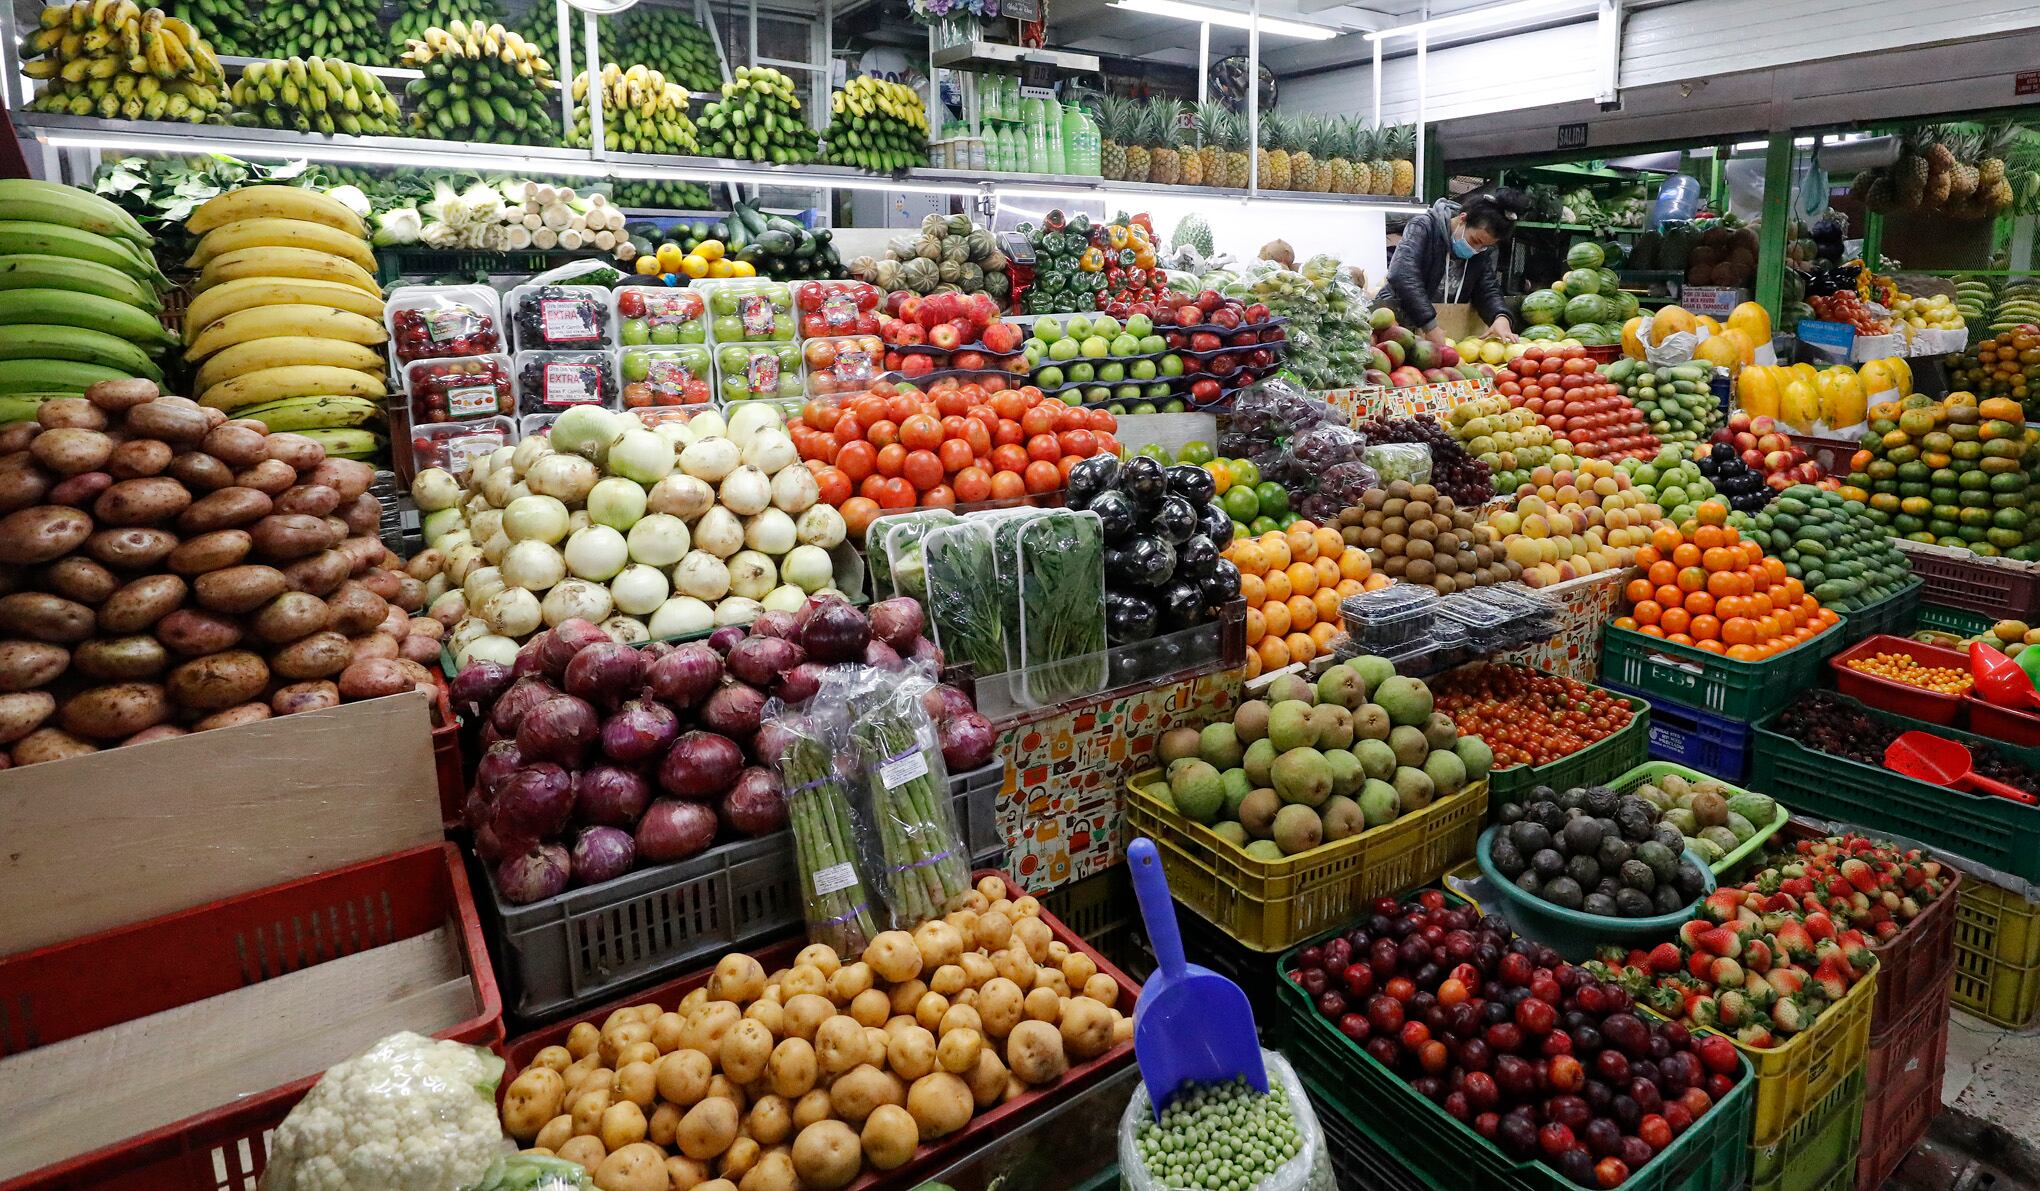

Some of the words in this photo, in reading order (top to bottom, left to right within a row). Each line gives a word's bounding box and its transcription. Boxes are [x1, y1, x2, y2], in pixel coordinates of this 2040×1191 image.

[1559, 127, 1585, 146] SALIDA
[547, 310, 578, 320] EXTRA
[549, 373, 580, 384] EXTRA
